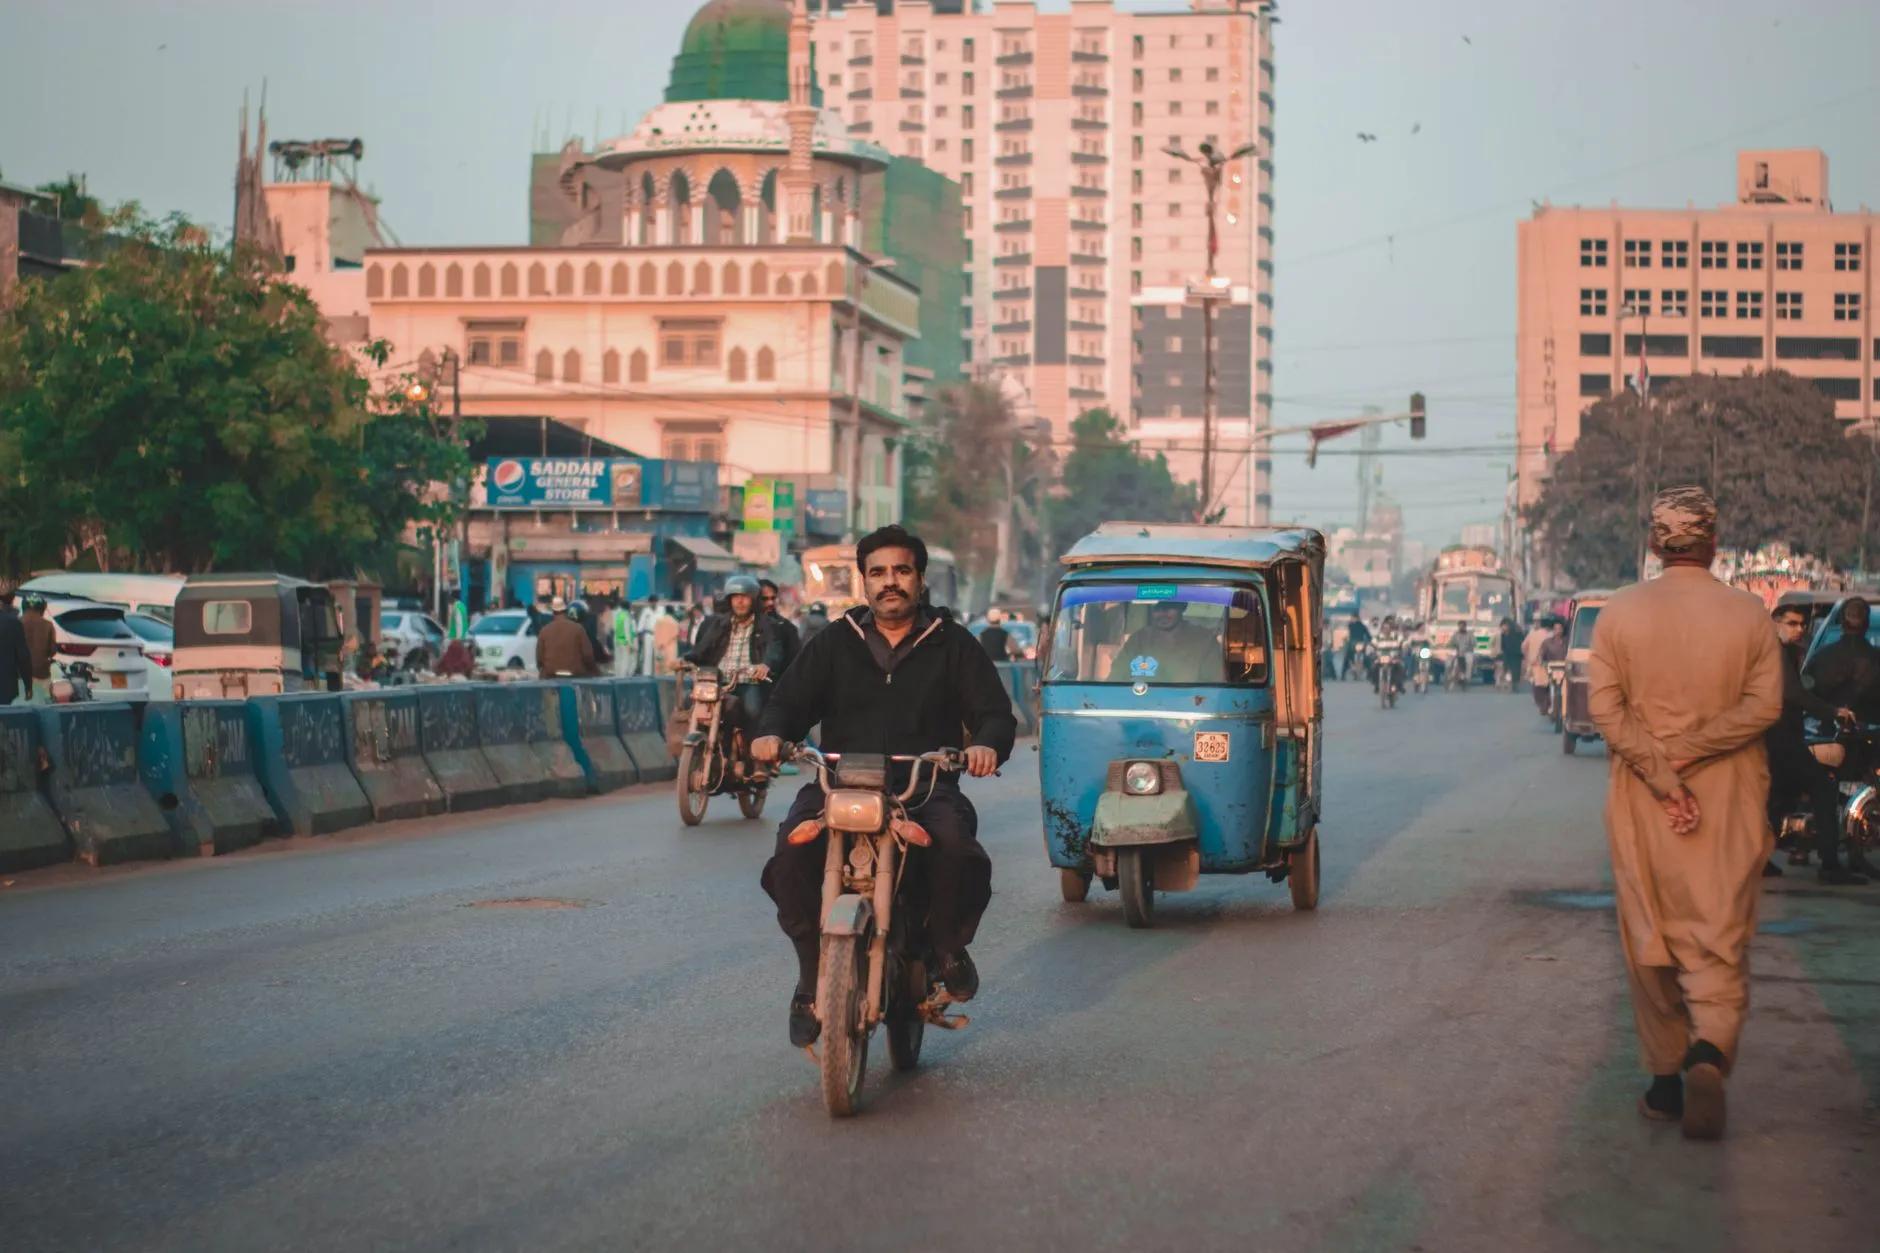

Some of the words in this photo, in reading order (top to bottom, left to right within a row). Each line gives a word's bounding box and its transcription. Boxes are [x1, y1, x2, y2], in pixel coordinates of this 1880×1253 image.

[530, 461, 605, 476] SADDAR
[536, 477, 598, 488] GENERAL
[545, 488, 590, 500] STORE
